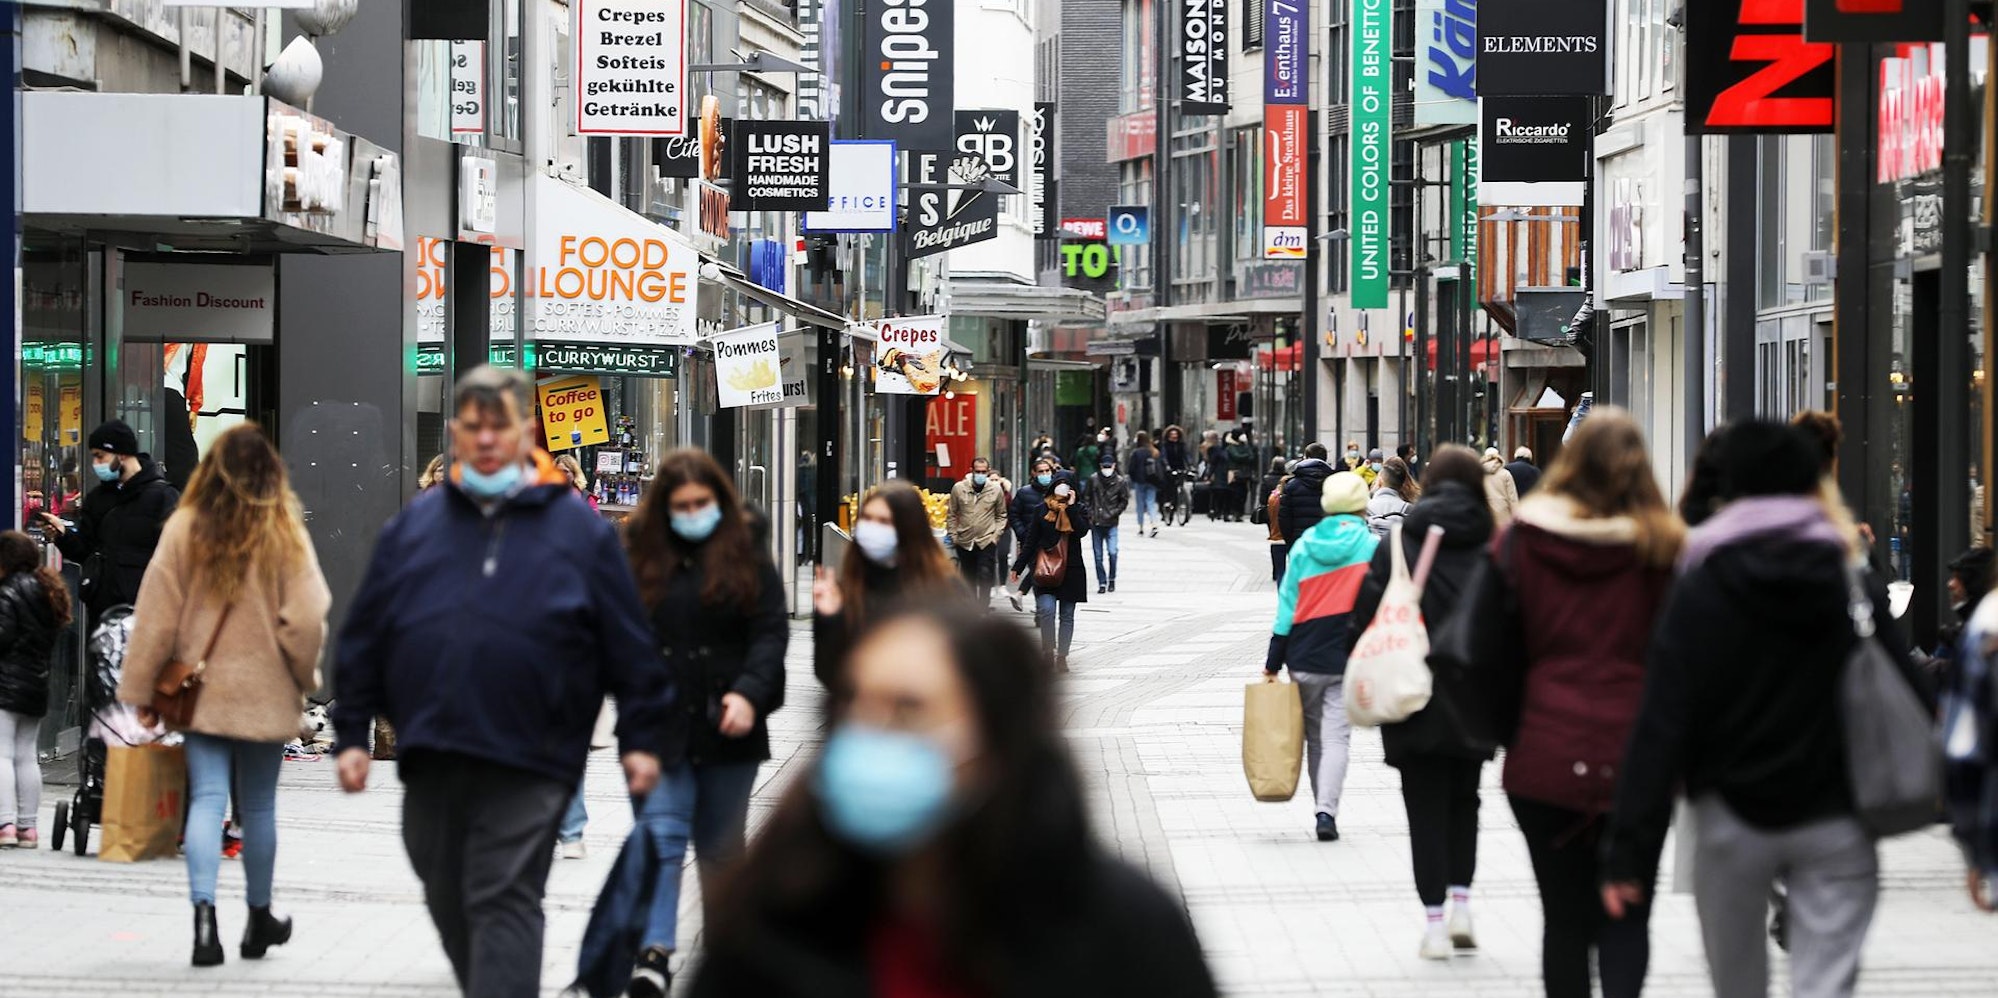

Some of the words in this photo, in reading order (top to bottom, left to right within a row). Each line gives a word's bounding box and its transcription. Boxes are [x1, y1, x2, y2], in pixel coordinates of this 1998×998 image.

[598, 8, 665, 24] Crepes
[601, 32, 663, 46] Brezel
[1484, 36, 1597, 53] ELEMENTS
[1185, 0, 1206, 102] MAISON
[597, 55, 665, 70] Softeis
[881, 0, 939, 123] snipe
[588, 78, 675, 95] gekühlte
[1213, 78, 1224, 103] DU
[1362, 86, 1379, 113] OF
[585, 102, 678, 117] Getränke
[1496, 118, 1568, 135] Riccardo
[748, 134, 819, 153] LUSH
[1282, 110, 1294, 163] Steakhaus
[748, 156, 819, 173] FRESH
[1362, 121, 1379, 202] COLORS
[748, 176, 819, 186] HANDMADE
[1282, 166, 1294, 197] kleine
[748, 187, 819, 198] COSMETICS
[828, 196, 885, 209] FFICE
[1282, 200, 1294, 220] Das
[913, 217, 992, 250] Belgique
[1273, 231, 1300, 247] dm
[560, 235, 668, 270] FOOD
[1362, 210, 1379, 280] UNITED
[540, 267, 687, 303] LOUNGE
[131, 290, 191, 307] Fashion
[196, 291, 265, 309] Discount
[881, 324, 938, 348] Crepes
[716, 339, 776, 359] Pommes
[545, 388, 597, 408] Coffee
[751, 390, 782, 403] Frites
[783, 382, 806, 397] urst
[548, 411, 566, 424] to
[572, 406, 594, 423] go
[926, 401, 969, 436] ALE
